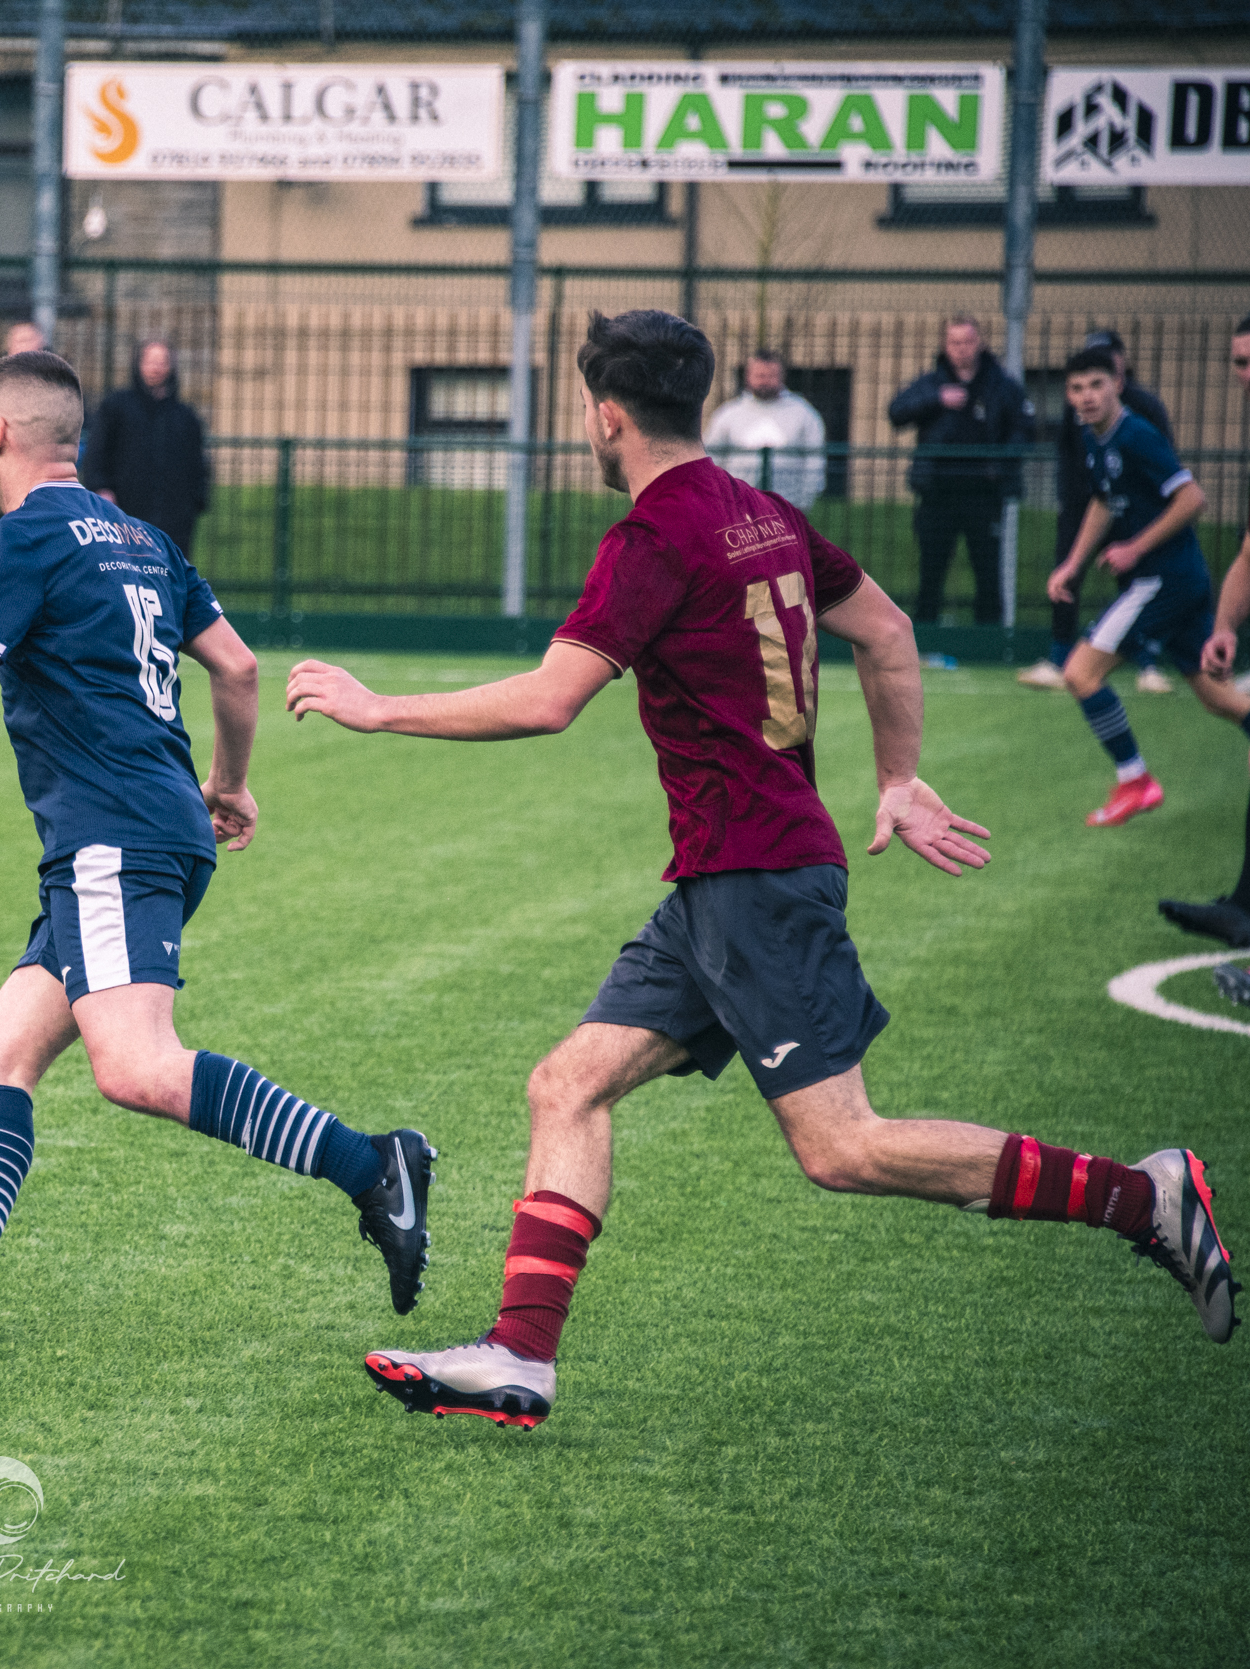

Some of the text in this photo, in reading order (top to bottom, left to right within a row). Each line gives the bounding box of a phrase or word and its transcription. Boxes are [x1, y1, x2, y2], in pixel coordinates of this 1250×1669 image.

[189, 75, 443, 127] CALGAR
[574, 91, 981, 151] HARAN
[725, 518, 786, 549] CHAPMAN
[143, 565, 169, 577] CENTRE
[122, 584, 178, 722] 15
[744, 571, 817, 751] 17
